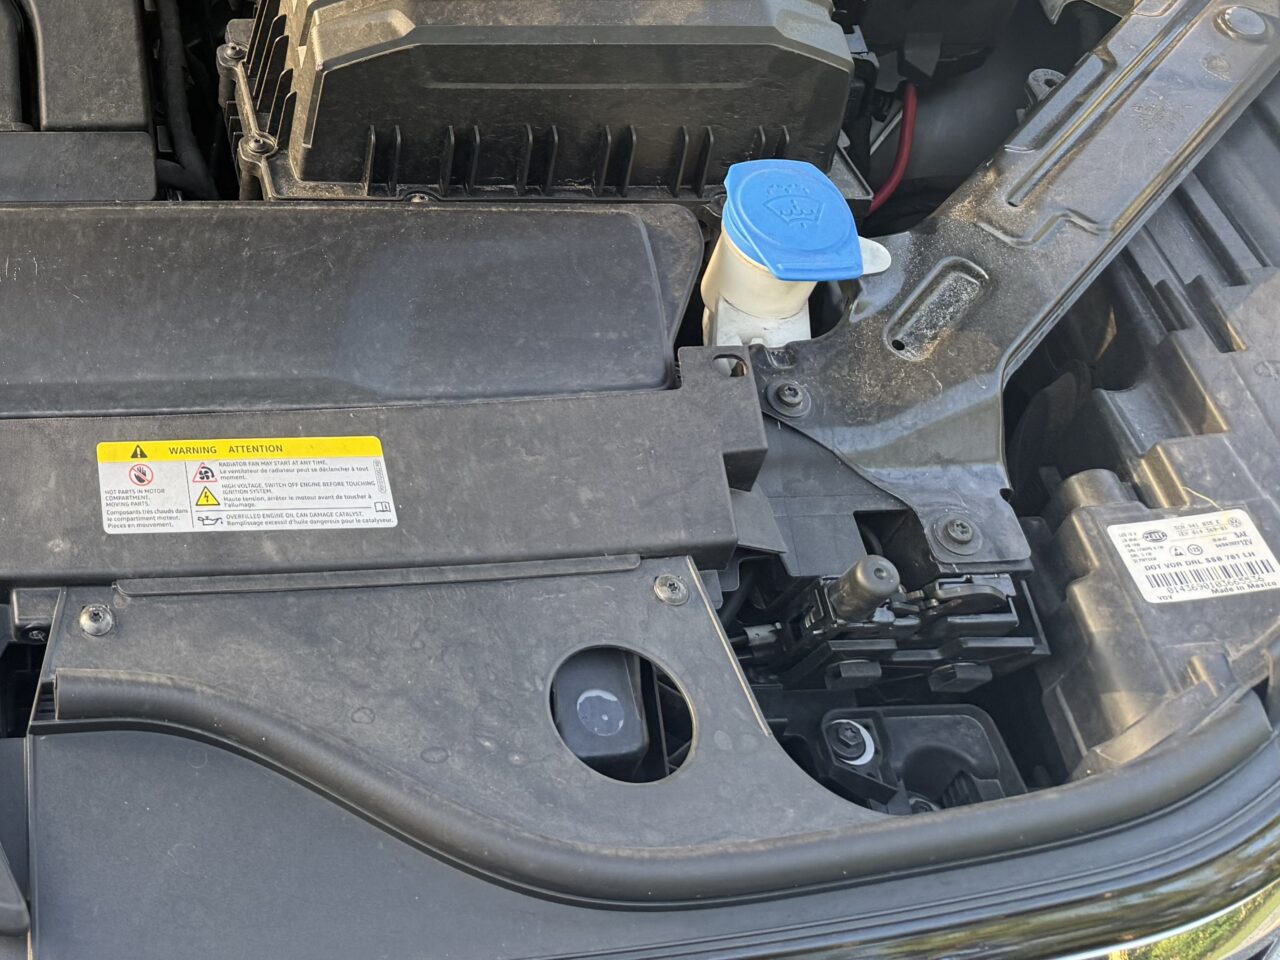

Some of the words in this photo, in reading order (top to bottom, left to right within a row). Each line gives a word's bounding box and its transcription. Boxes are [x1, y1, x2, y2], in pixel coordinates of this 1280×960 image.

[169, 446, 217, 454] WARNING
[229, 445, 282, 453] ATTENTION
[1145, 563, 1162, 572] DOT
[1164, 561, 1182, 569] VOR
[1186, 558, 1201, 566] DRL
